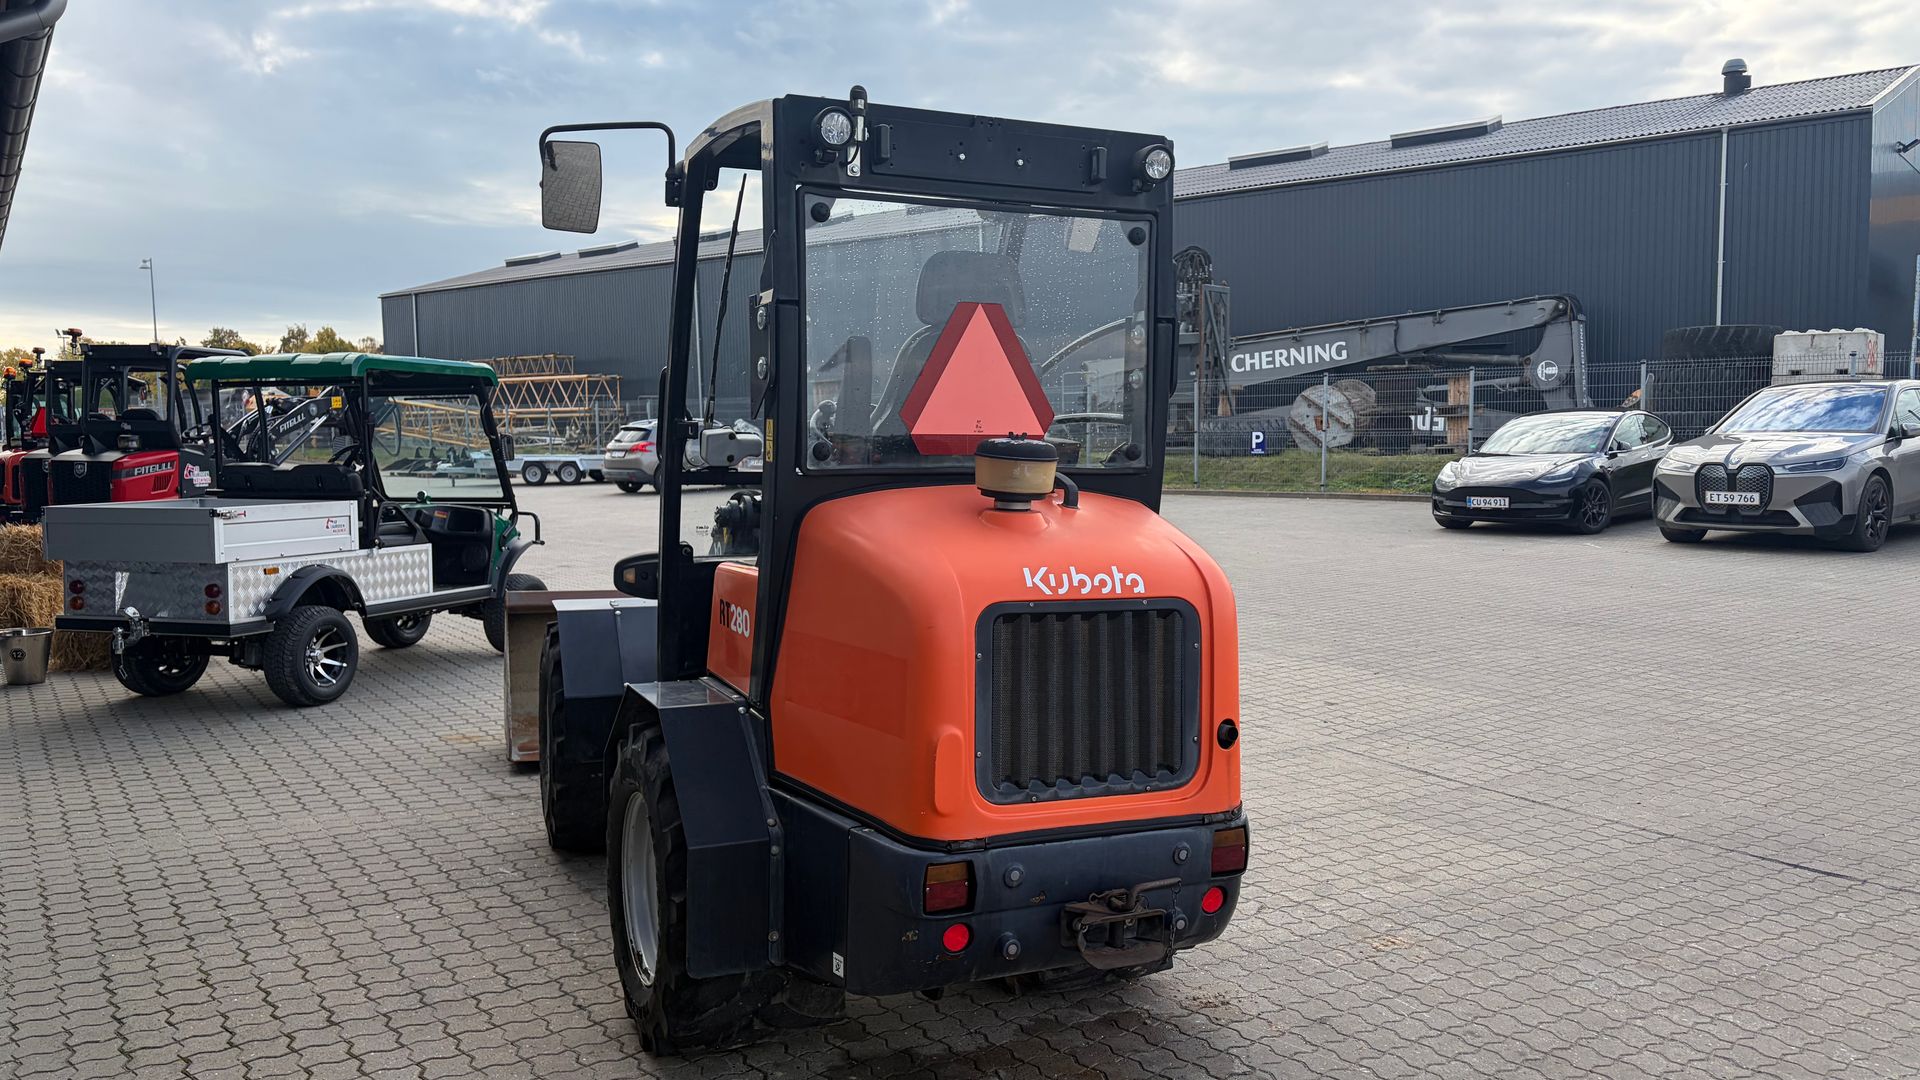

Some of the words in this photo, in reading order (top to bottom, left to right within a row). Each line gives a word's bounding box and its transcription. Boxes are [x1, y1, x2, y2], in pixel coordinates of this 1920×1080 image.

[280, 412, 306, 433] PITBULL
[1252, 431, 1264, 449] P
[134, 461, 173, 476] PITBULL
[1472, 498, 1482, 506] CU
[1709, 493, 1722, 502] ET
[1723, 493, 1735, 502] 59
[1738, 494, 1756, 503] 766
[1022, 565, 1146, 595] Kubota
[719, 598, 751, 639] RT280
